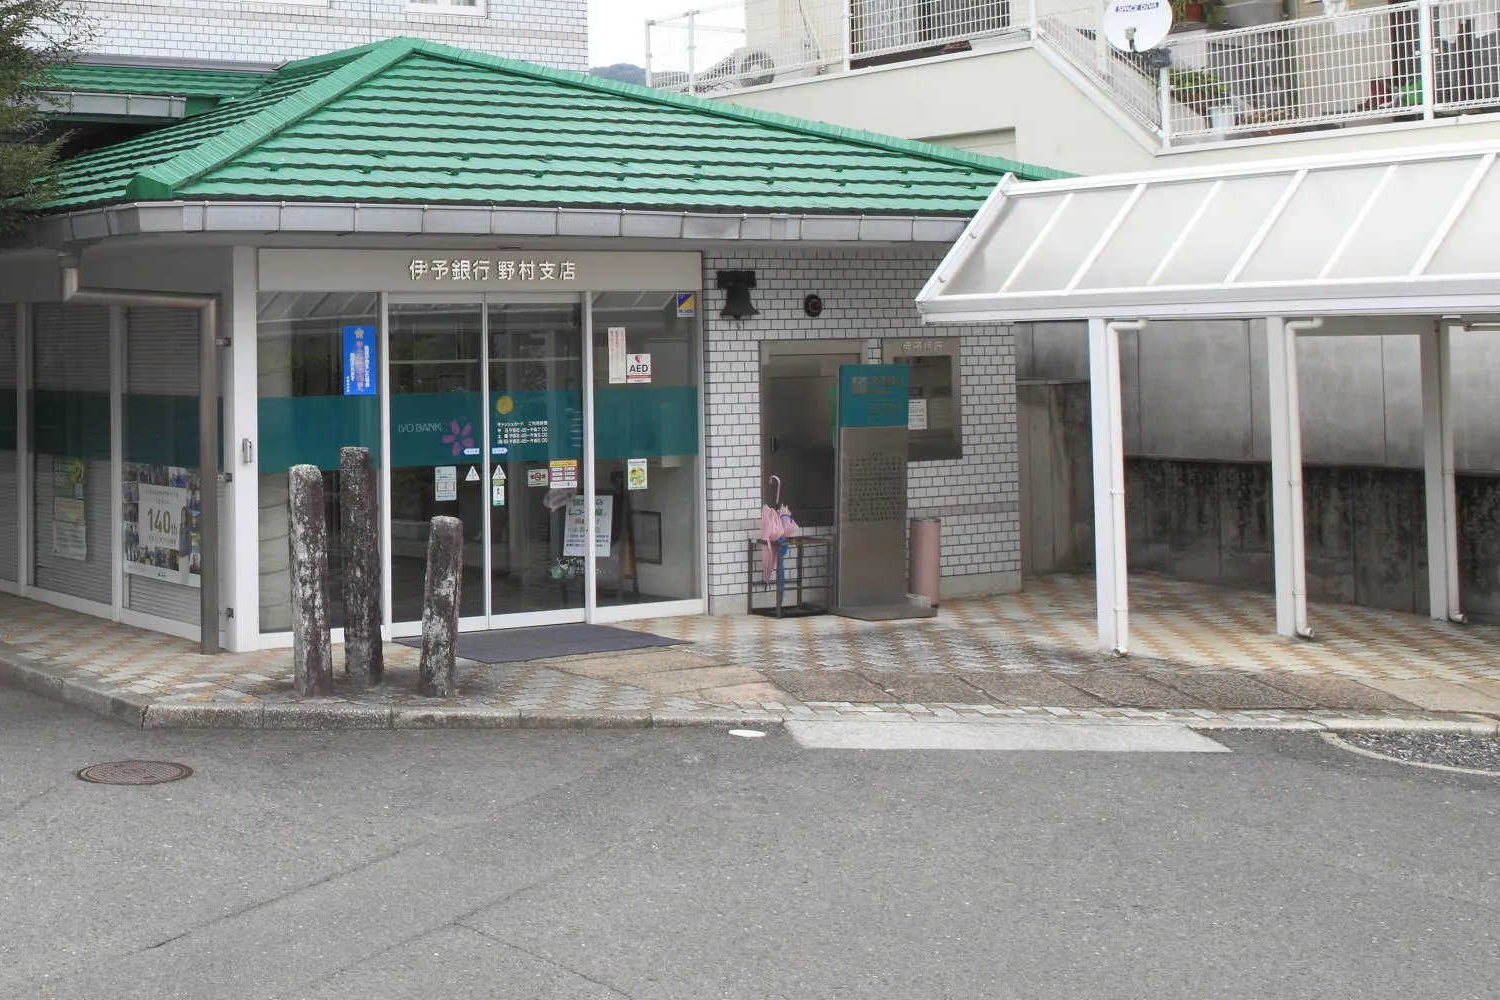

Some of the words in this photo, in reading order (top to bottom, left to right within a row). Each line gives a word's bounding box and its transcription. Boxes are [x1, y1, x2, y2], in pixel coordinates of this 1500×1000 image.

[409, 259, 490, 280] 伊予銀行
[498, 260, 576, 280] 野村支店
[629, 364, 649, 373] AED
[398, 423, 414, 433] IYO
[415, 422, 442, 432] BANK
